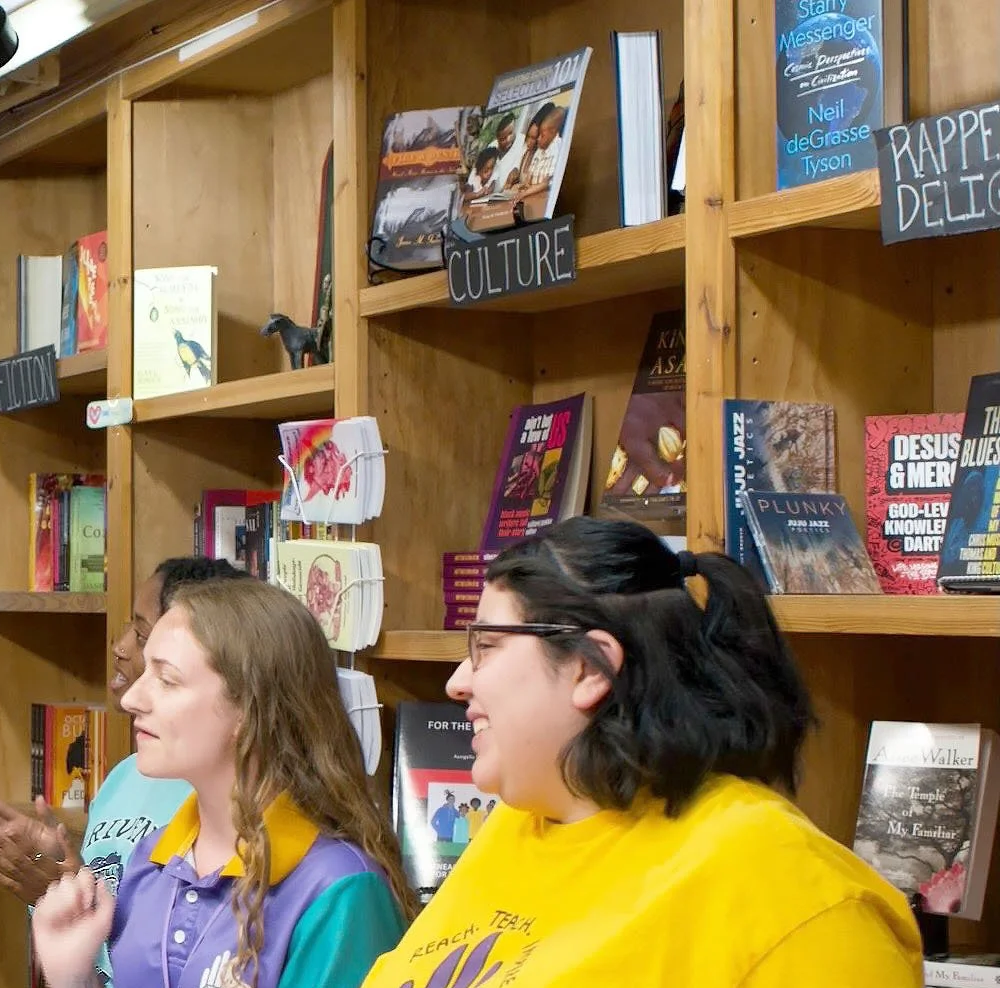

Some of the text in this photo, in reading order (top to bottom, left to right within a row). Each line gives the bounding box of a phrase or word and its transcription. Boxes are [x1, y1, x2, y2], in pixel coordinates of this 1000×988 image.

[779, 15, 875, 51] Messenger
[549, 54, 581, 90] 101
[808, 99, 844, 124] Neil
[787, 125, 871, 154] deGrasse
[801, 153, 852, 178] Tyson
[449, 224, 572, 303] CULTURE
[733, 412, 745, 460] JAZZ
[893, 433, 962, 461] DESUS
[889, 461, 905, 489] &
[757, 499, 847, 516] PLUNKY
[82, 525, 105, 539] Co
[427, 720, 471, 731] FOR THE
[921, 748, 975, 766] Walker
[907, 786, 946, 804] Temple
[902, 807, 914, 818] of
[887, 821, 957, 840] My Familiar
